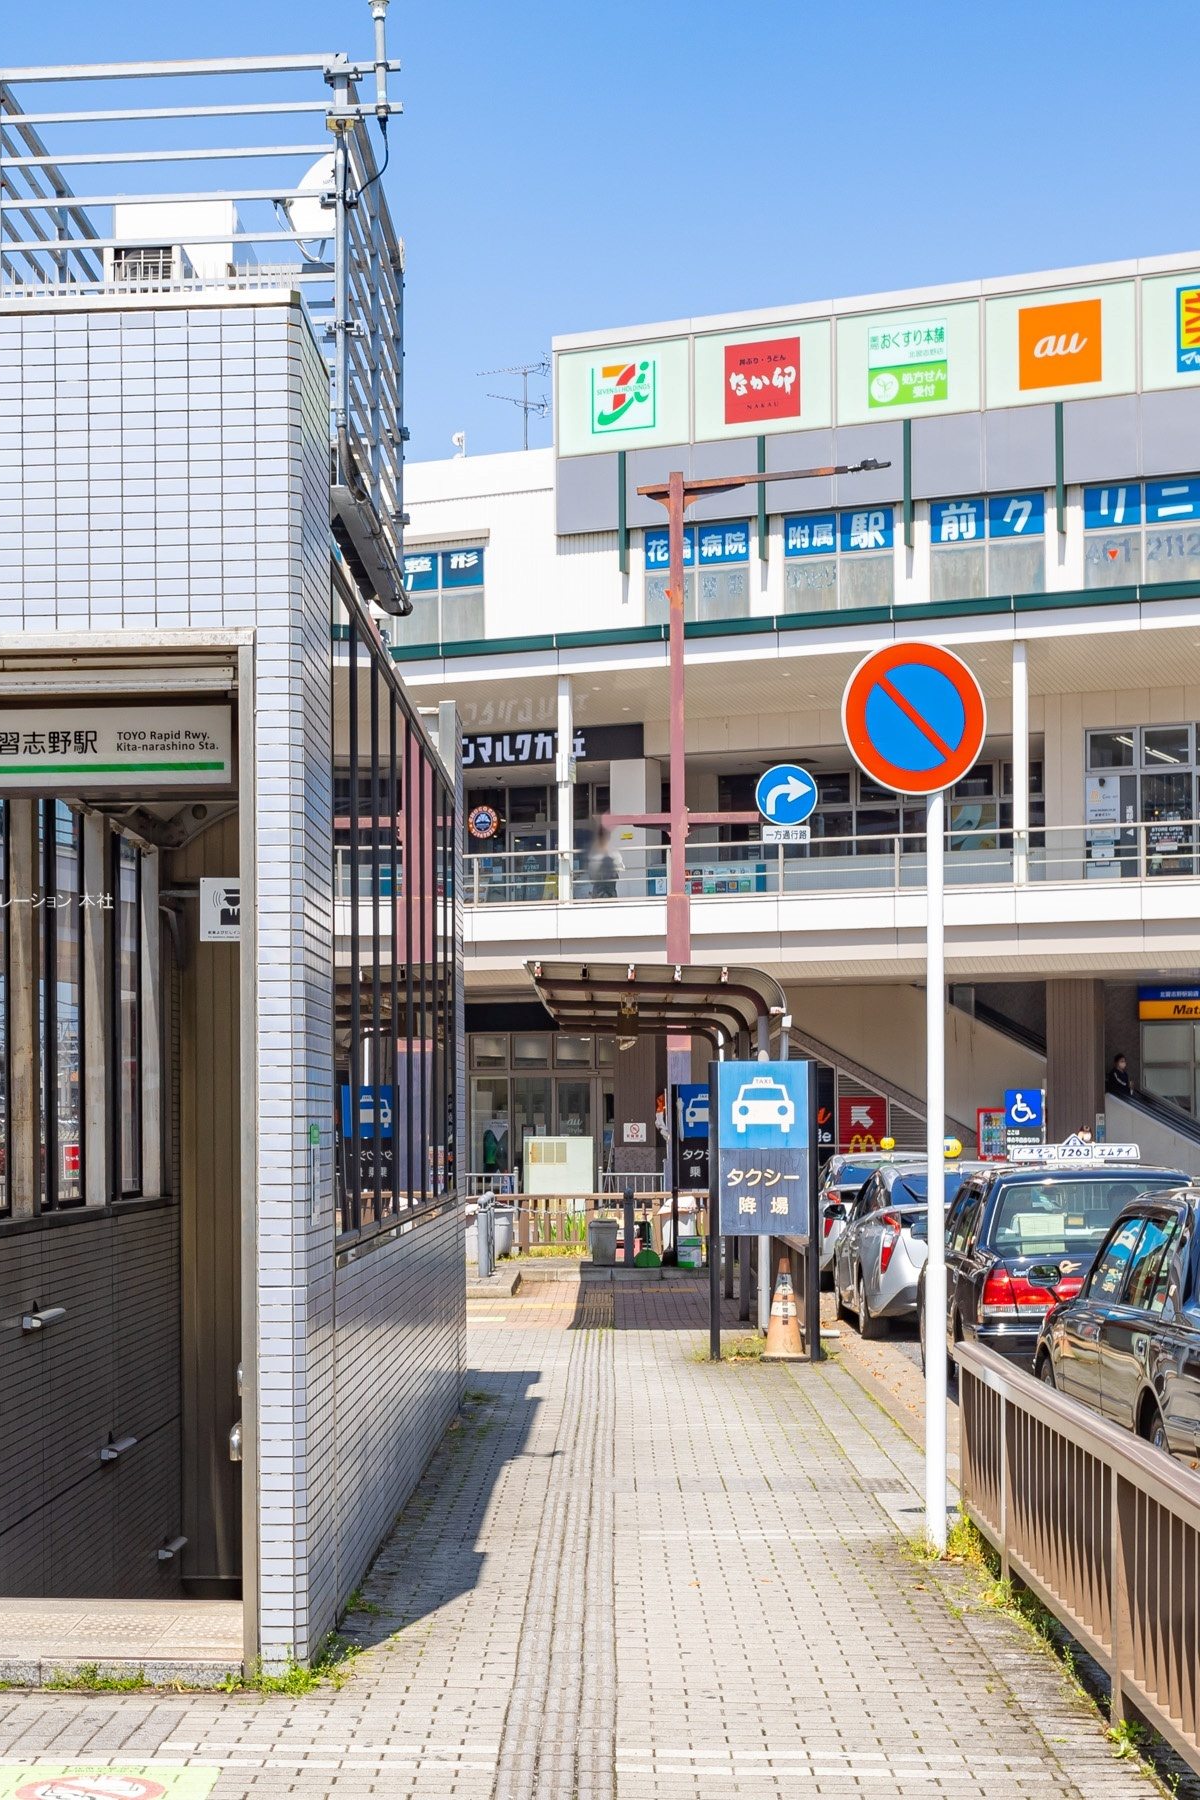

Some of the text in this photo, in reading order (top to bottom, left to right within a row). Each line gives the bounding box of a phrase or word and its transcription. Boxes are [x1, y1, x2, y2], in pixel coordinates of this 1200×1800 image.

[880, 326, 945, 349] おくすり本舗
[1033, 332, 1088, 359] au
[729, 365, 797, 396] なか卯
[901, 369, 947, 386] 処方せん
[912, 384, 936, 398] 受付
[746, 401, 779, 410] NAKAU
[116, 730, 210, 742] TOYO Rapid Rwy.
[116, 741, 219, 752] Kita-narashino Sta.
[1173, 1004, 1200, 1015] Mat
[1061, 1148, 1090, 1157] 7263
[726, 1168, 800, 1187] タクシー
